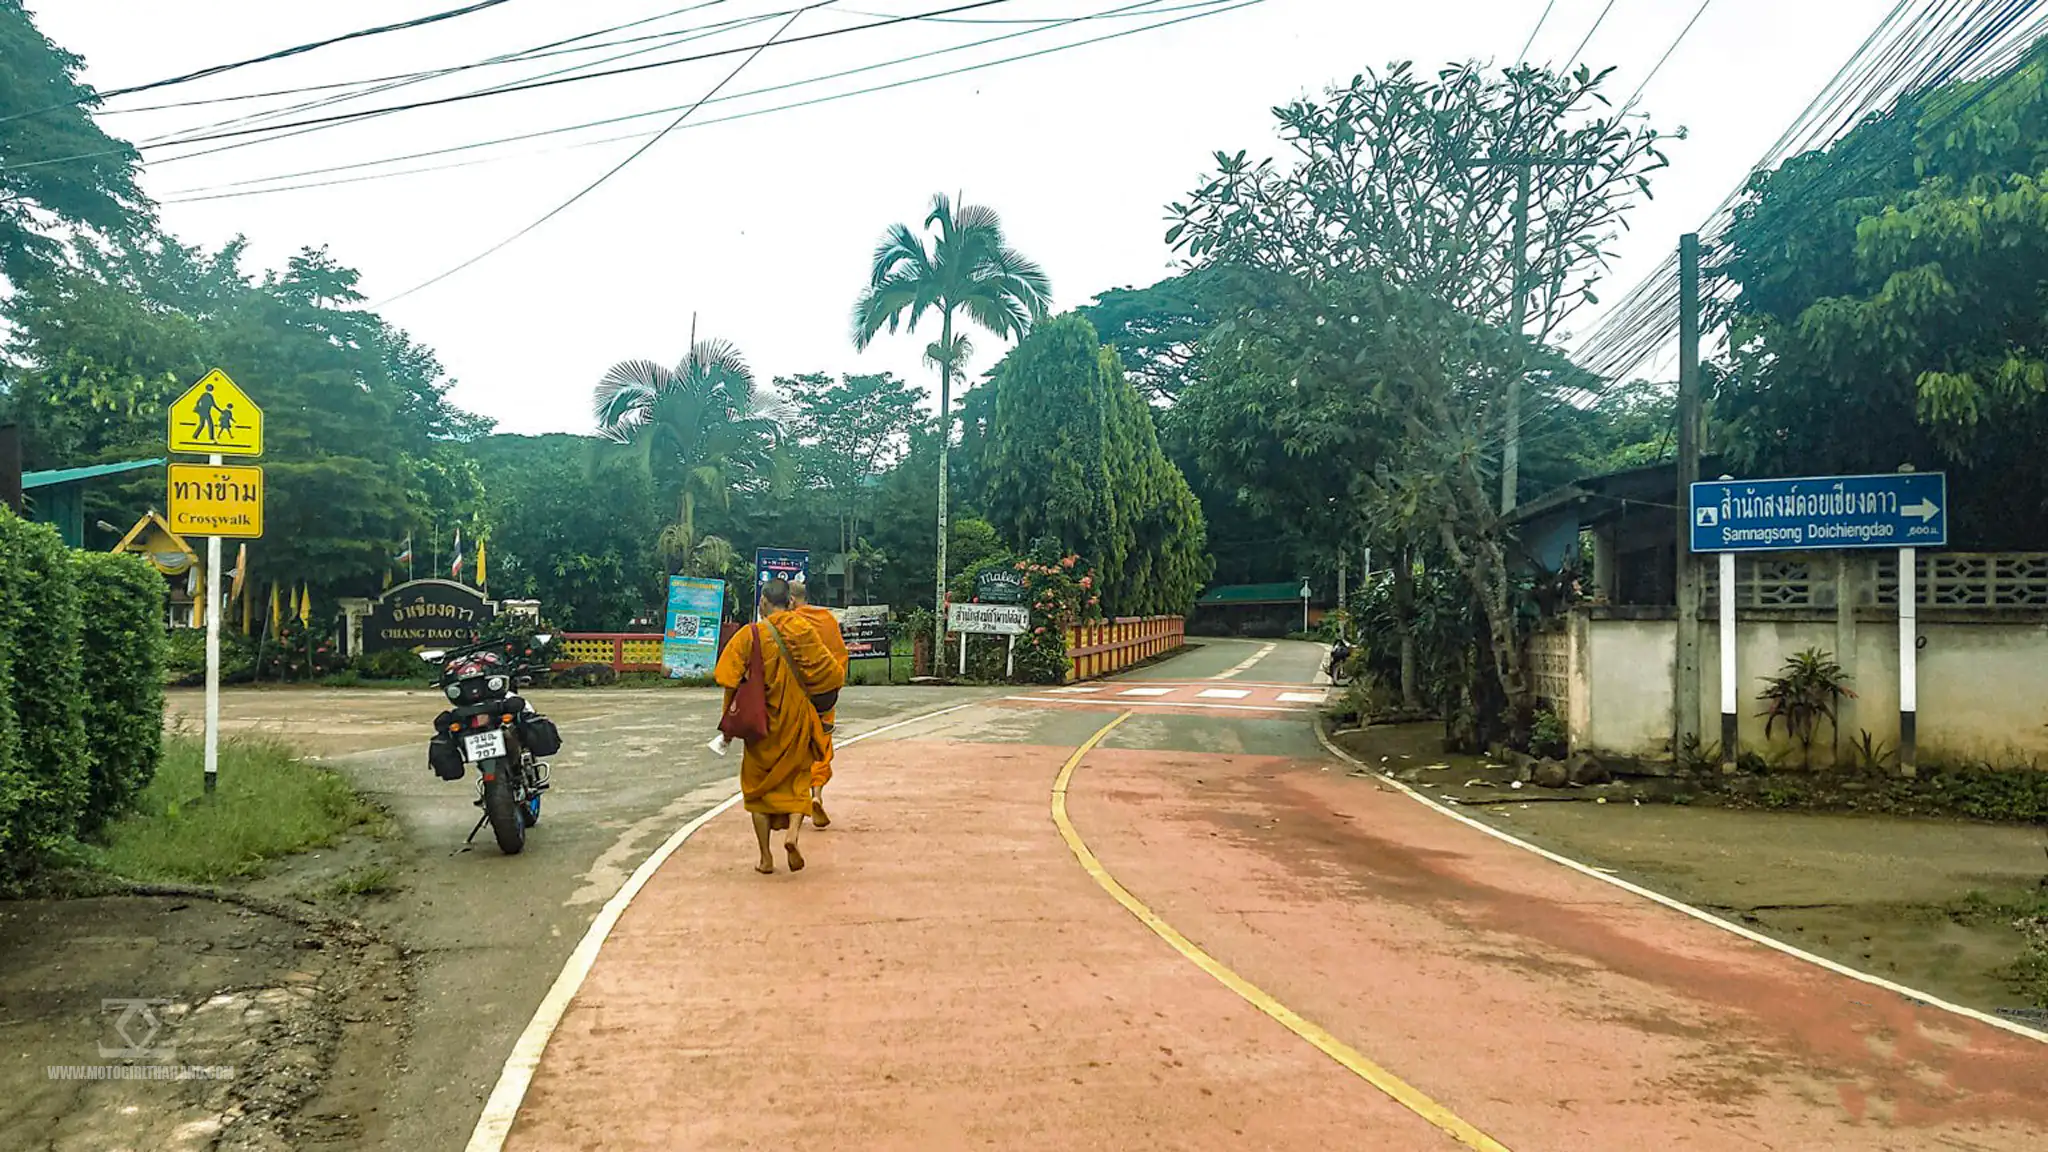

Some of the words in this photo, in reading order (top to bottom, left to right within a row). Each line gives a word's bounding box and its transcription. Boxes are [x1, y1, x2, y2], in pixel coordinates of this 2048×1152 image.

[174, 475, 257, 502] ทางข้าม
[1721, 484, 1897, 520] สำนักสงฆ์ดอยเชียงดาว
[178, 512, 251, 526] Crosswalk
[1722, 525, 1802, 543] Samnagsong
[1808, 522, 1894, 541] Doichiengdao
[381, 628, 425, 640] CHIANG
[427, 628, 452, 639] DAO
[475, 747, 496, 759] 707
